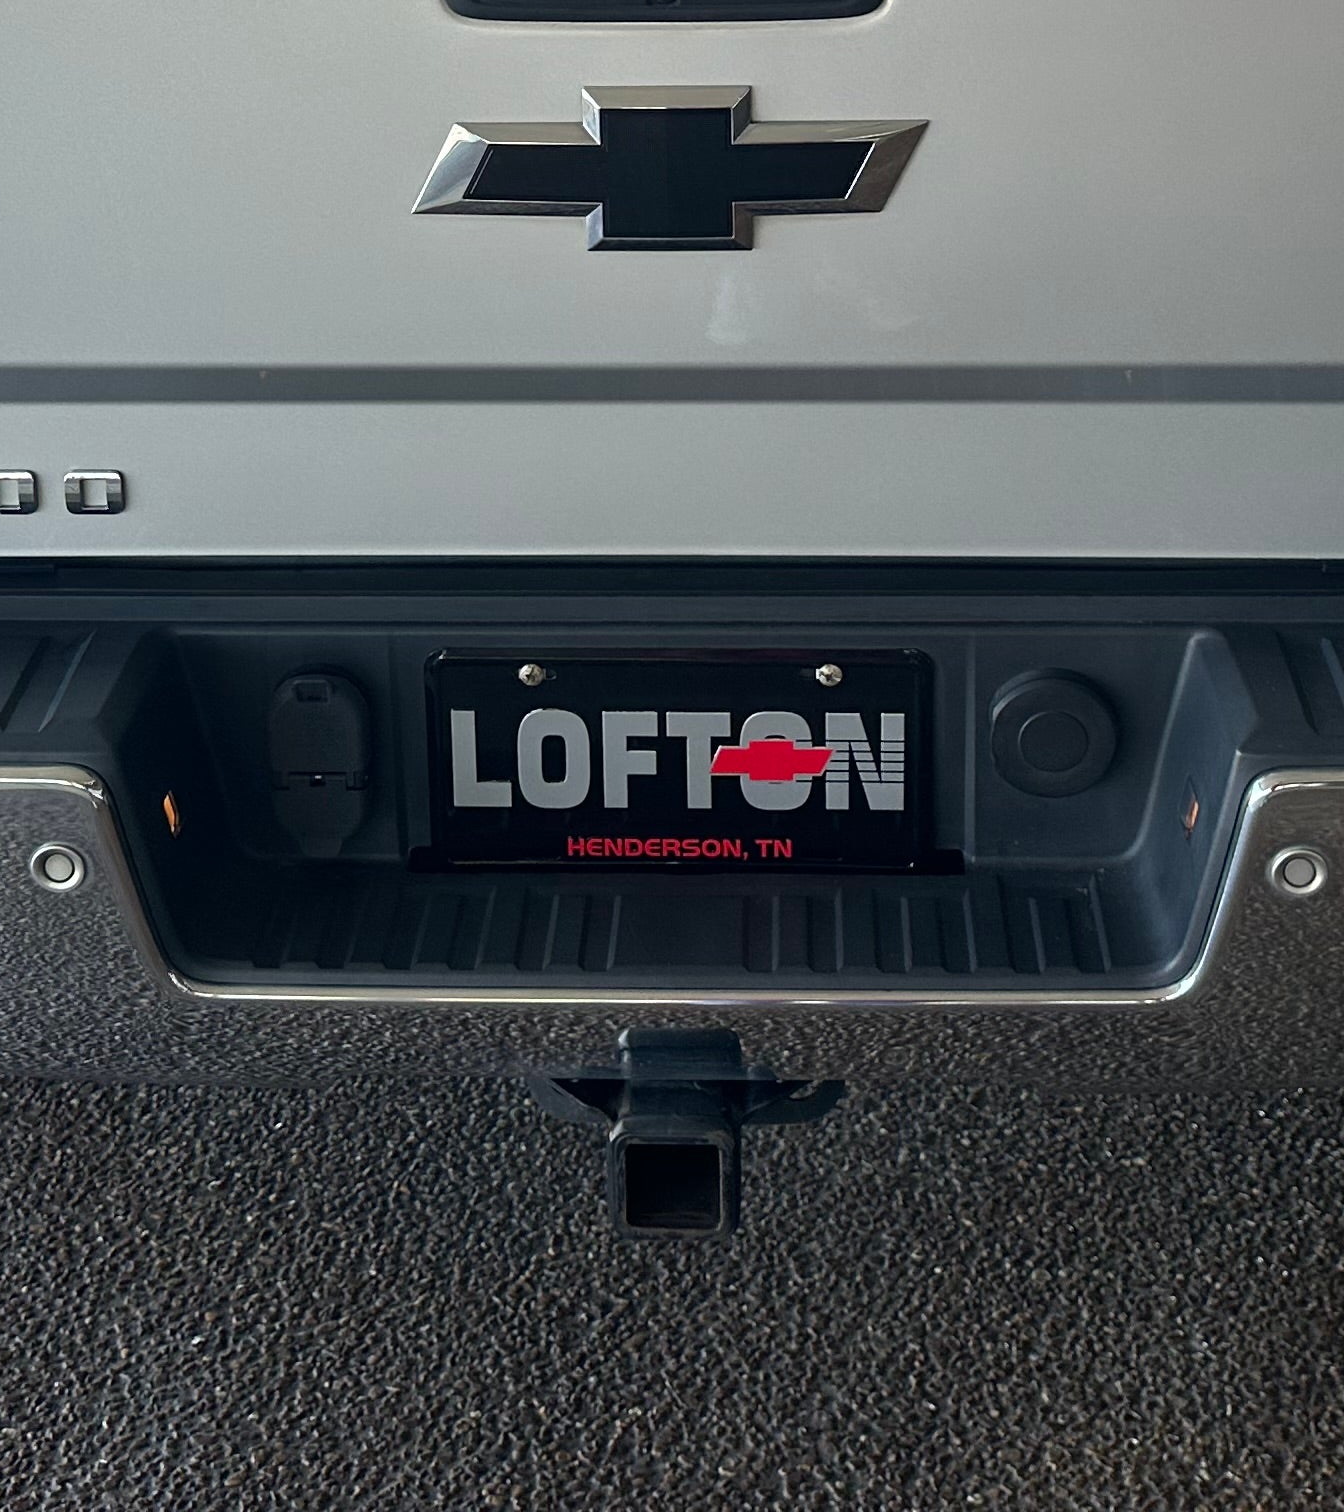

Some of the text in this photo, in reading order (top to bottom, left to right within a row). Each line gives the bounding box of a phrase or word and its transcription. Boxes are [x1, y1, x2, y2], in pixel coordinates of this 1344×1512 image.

[450, 708, 905, 811] LOFTON
[567, 836, 793, 861] HENDERSON, TN
